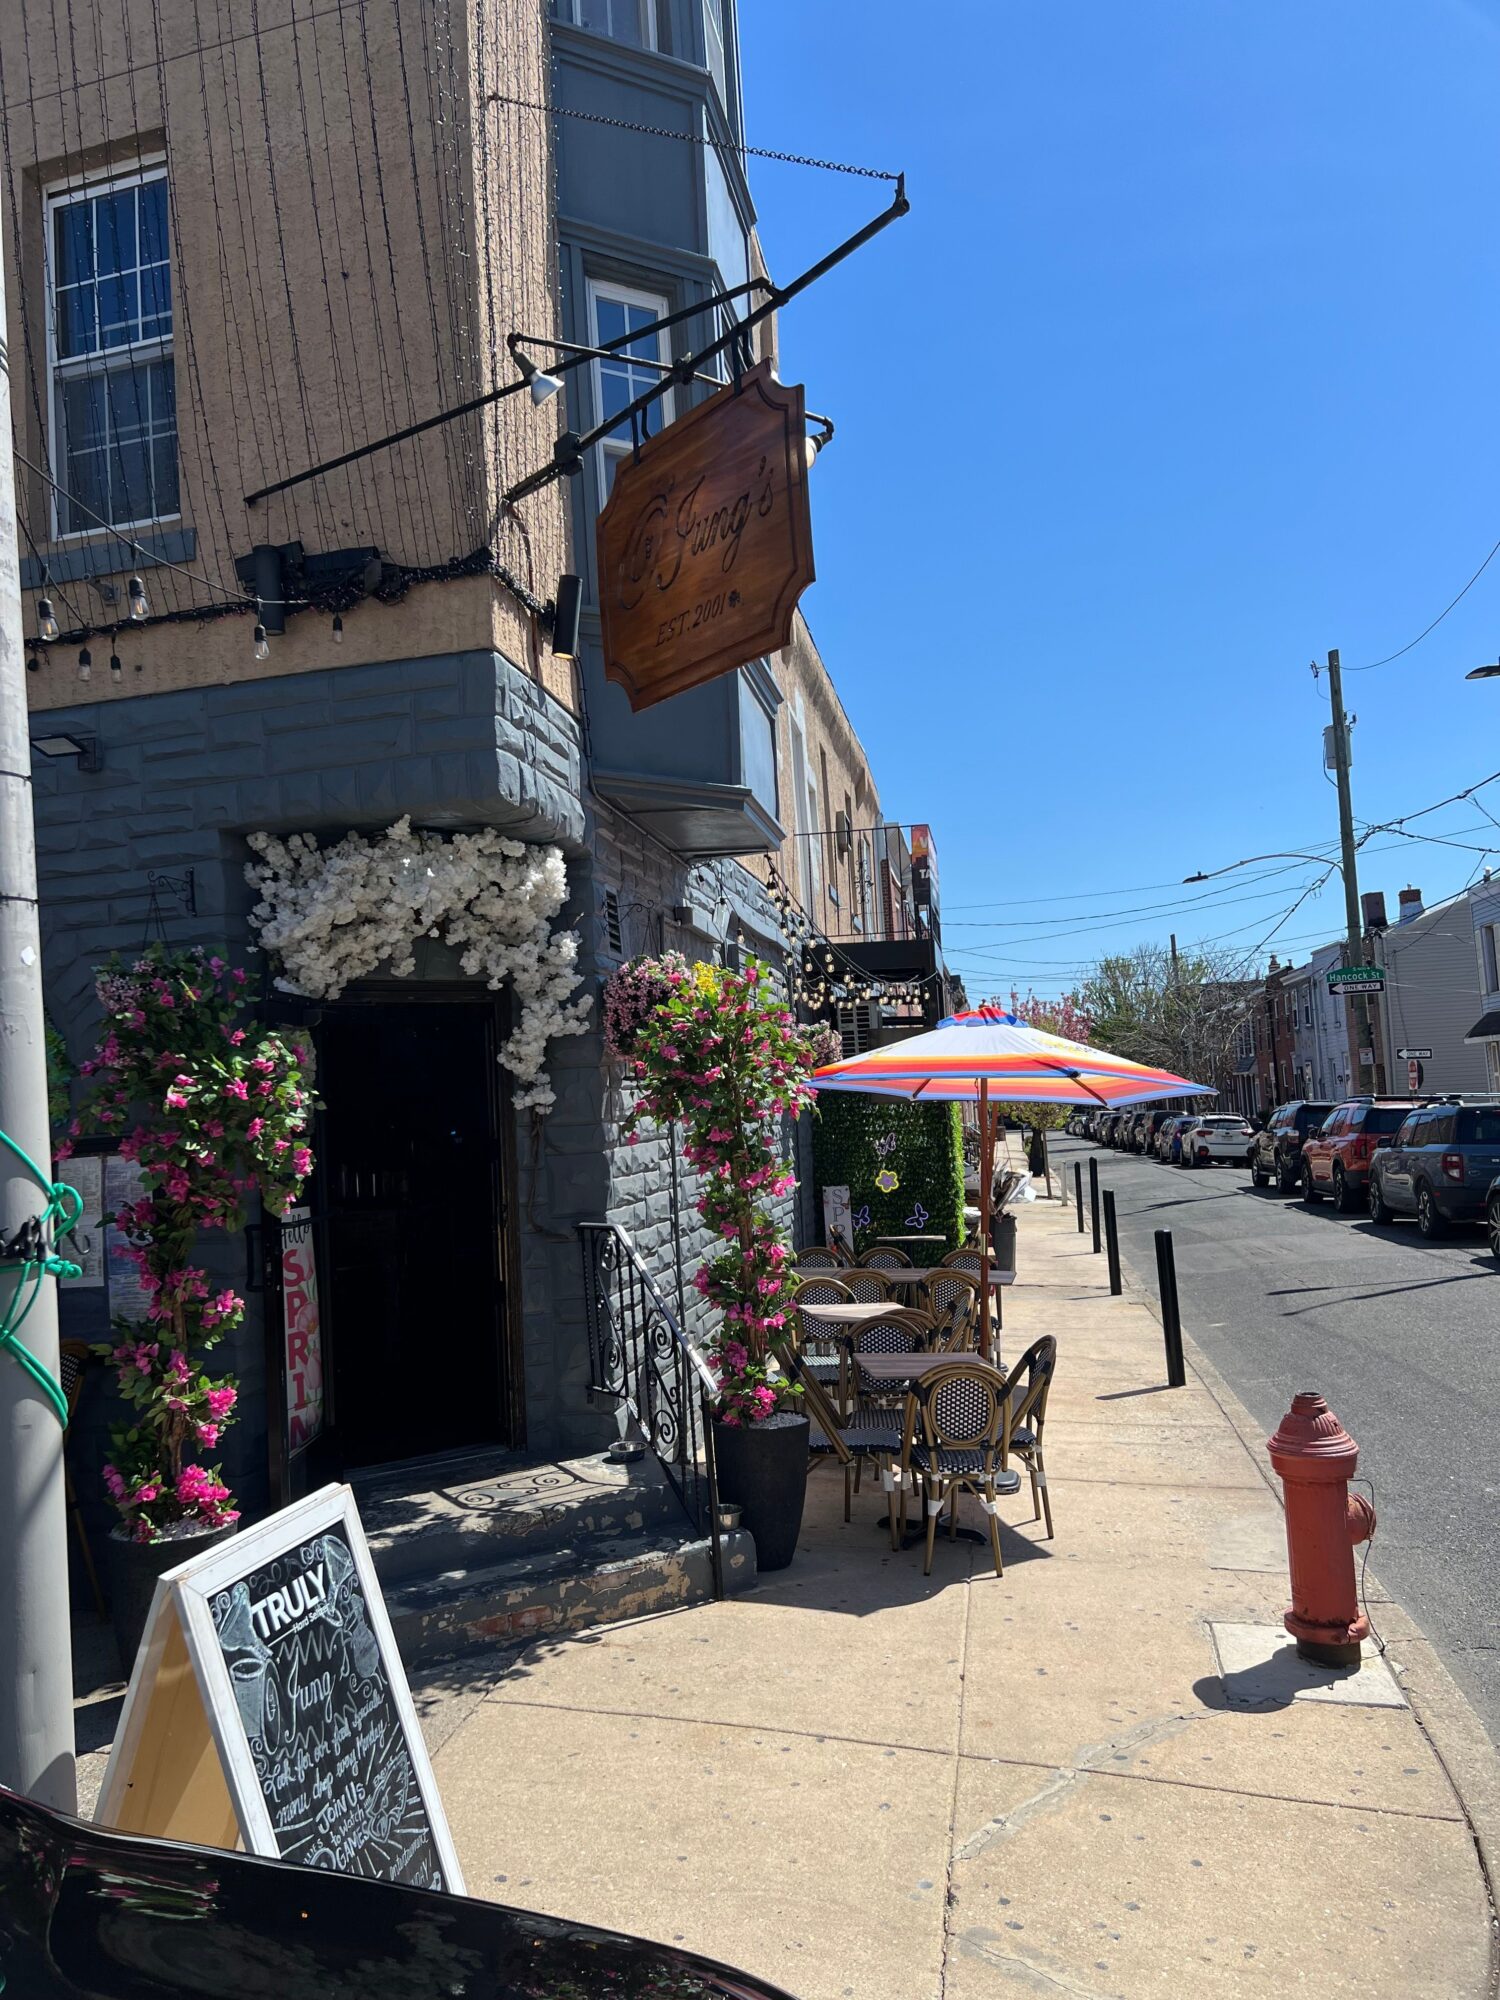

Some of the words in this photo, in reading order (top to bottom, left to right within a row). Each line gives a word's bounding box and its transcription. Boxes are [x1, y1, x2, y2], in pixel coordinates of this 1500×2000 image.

[1328, 971, 1368, 982] Hancock
[1371, 970, 1380, 979] St
[1344, 984, 1359, 992] ONE
[250, 1562, 327, 1639] TRULY
[292, 1616, 310, 1634] Hard
[263, 1758, 297, 1803] Look
[294, 1748, 314, 1783] for
[314, 1740, 331, 1762] our
[332, 1717, 352, 1757] food
[276, 1792, 312, 1827] menu
[312, 1767, 334, 1800] drop
[335, 1748, 359, 1778] every
[330, 1831, 342, 1847] to
[335, 1820, 370, 1871] GAMES
